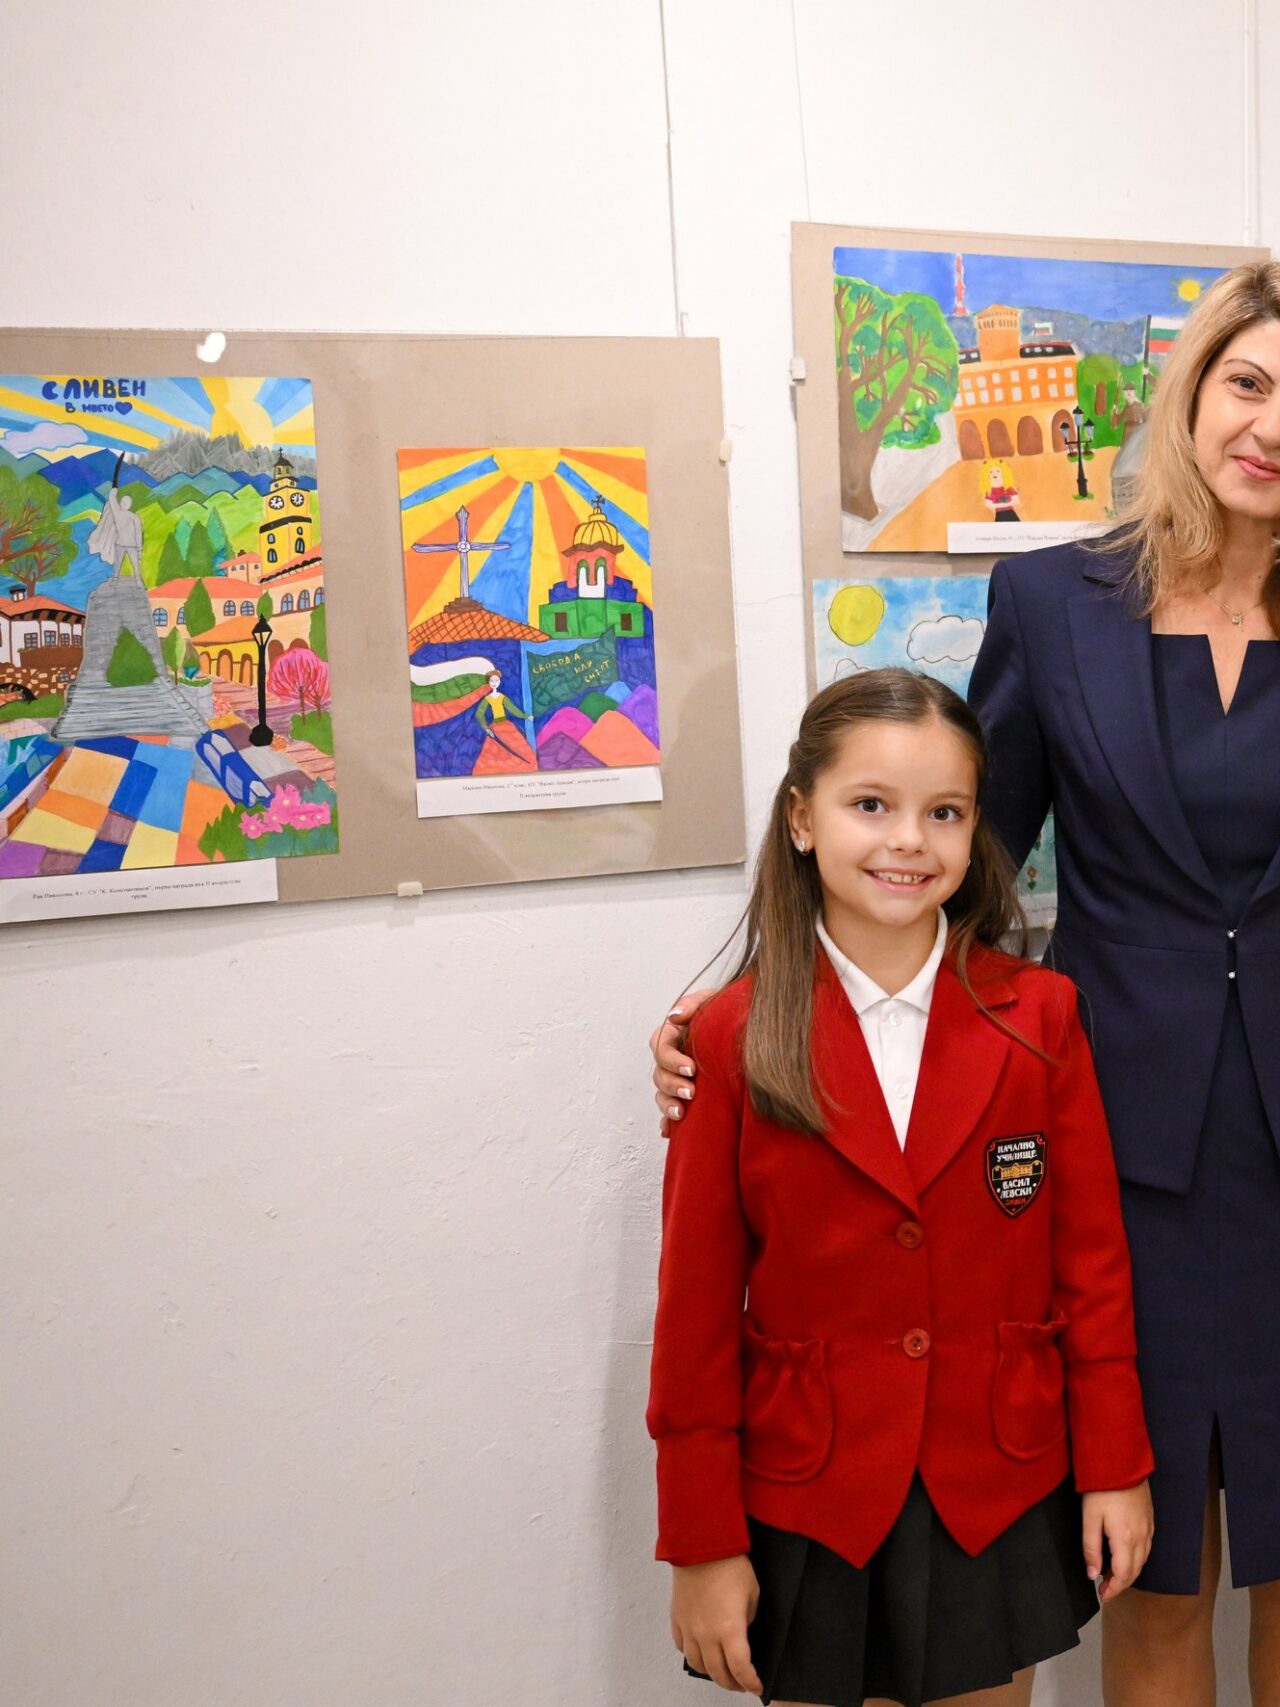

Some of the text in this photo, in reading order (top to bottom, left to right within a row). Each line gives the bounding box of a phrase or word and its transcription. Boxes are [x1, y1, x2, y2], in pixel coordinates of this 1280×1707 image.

[42, 378, 146, 400] СЛИВЕН
[997, 1141, 1036, 1154] НАЧАЛНО
[996, 1149, 1037, 1162] УЧИЛИЩЕ
[1002, 1178, 1030, 1190] ВАСИЛ
[1000, 1187, 1033, 1199] ЛЕВСКИ
